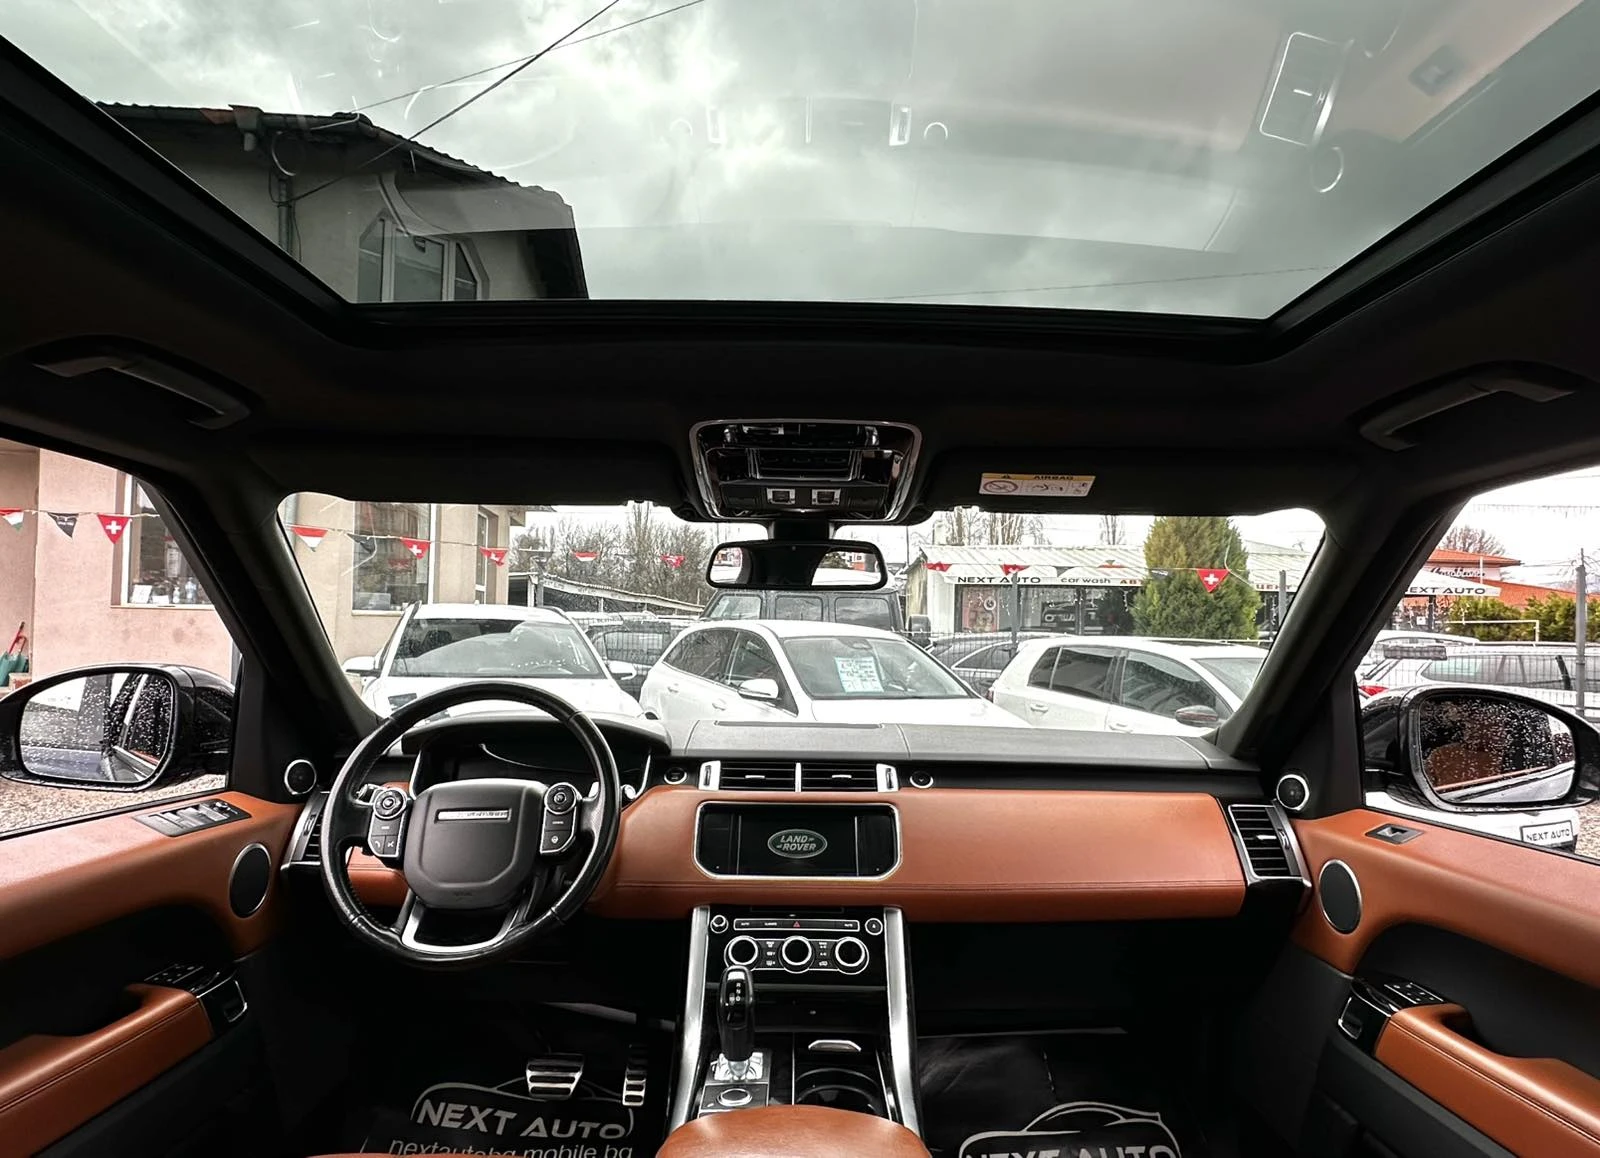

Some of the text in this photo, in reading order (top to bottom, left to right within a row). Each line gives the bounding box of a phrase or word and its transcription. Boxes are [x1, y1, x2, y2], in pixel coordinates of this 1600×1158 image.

[957, 576, 995, 584] NEXT
[999, 576, 1041, 584] AUTO
[1526, 828, 1570, 841] NEXT AUTO
[780, 835, 808, 843] LAND
[782, 843, 816, 851] ROVER
[416, 1099, 627, 1139] NEXT AUTO
